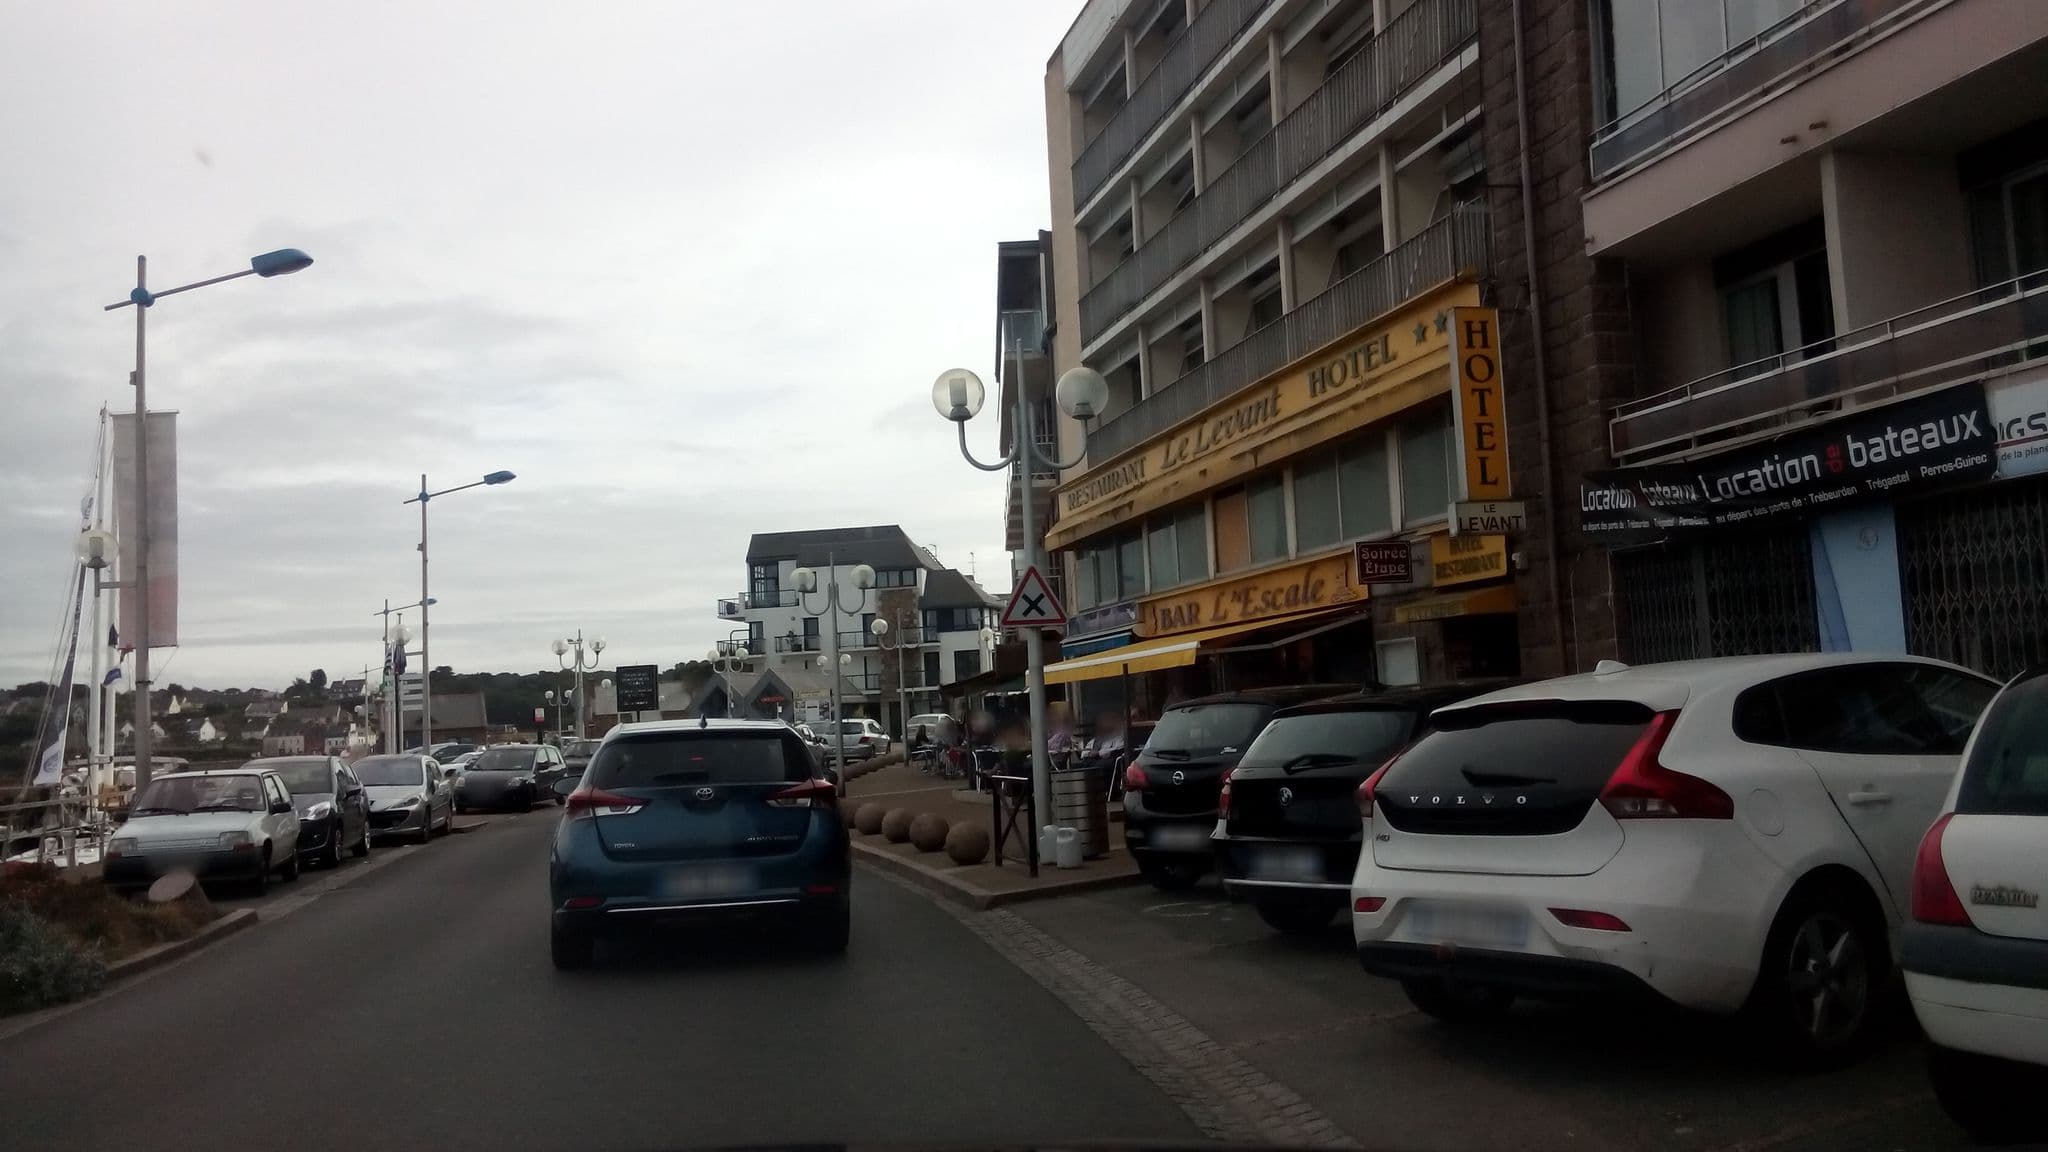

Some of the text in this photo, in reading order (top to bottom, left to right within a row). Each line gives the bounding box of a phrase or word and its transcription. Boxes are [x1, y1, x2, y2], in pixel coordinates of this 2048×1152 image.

[1464, 320, 1499, 486] HOTEL
[1068, 334, 1397, 510] RESTAURANT Le Levant HOTEL
[1698, 454, 1822, 503] Location
[1846, 410, 1982, 468] bateaux
[1920, 453, 1988, 478] Perros-Guirec
[1483, 504, 1496, 513] LE
[1581, 484, 1637, 511] Location
[1459, 515, 1522, 532] LEVANT
[1159, 603, 1200, 631] BAR
[1410, 795, 1527, 805] VOLVO
